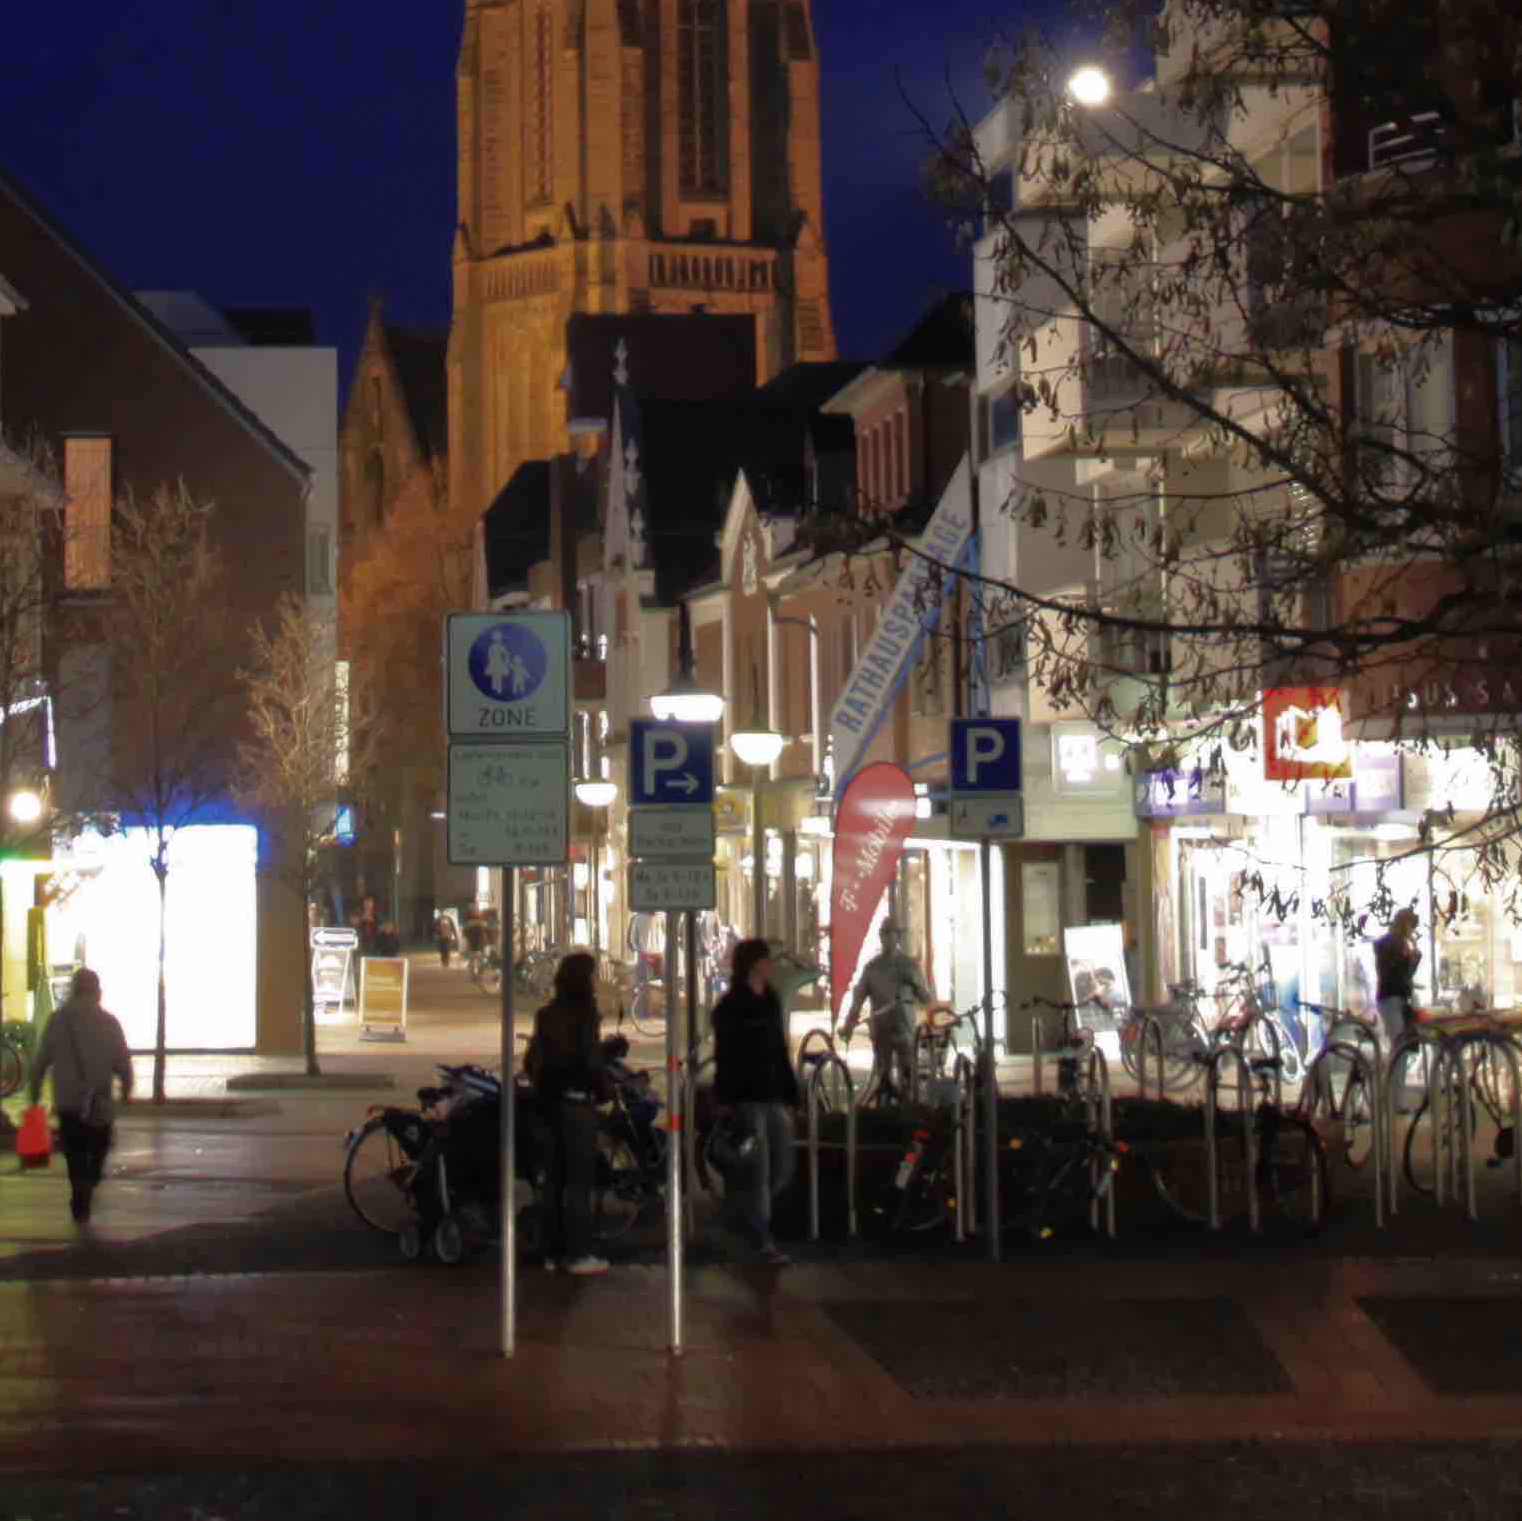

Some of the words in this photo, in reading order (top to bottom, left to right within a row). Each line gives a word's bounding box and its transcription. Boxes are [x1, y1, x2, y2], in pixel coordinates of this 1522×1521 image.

[835, 507, 968, 733] RATHAUSPAAGE
[478, 707, 536, 727] ZONE
[642, 729, 688, 796] P
[966, 727, 1006, 783] P
